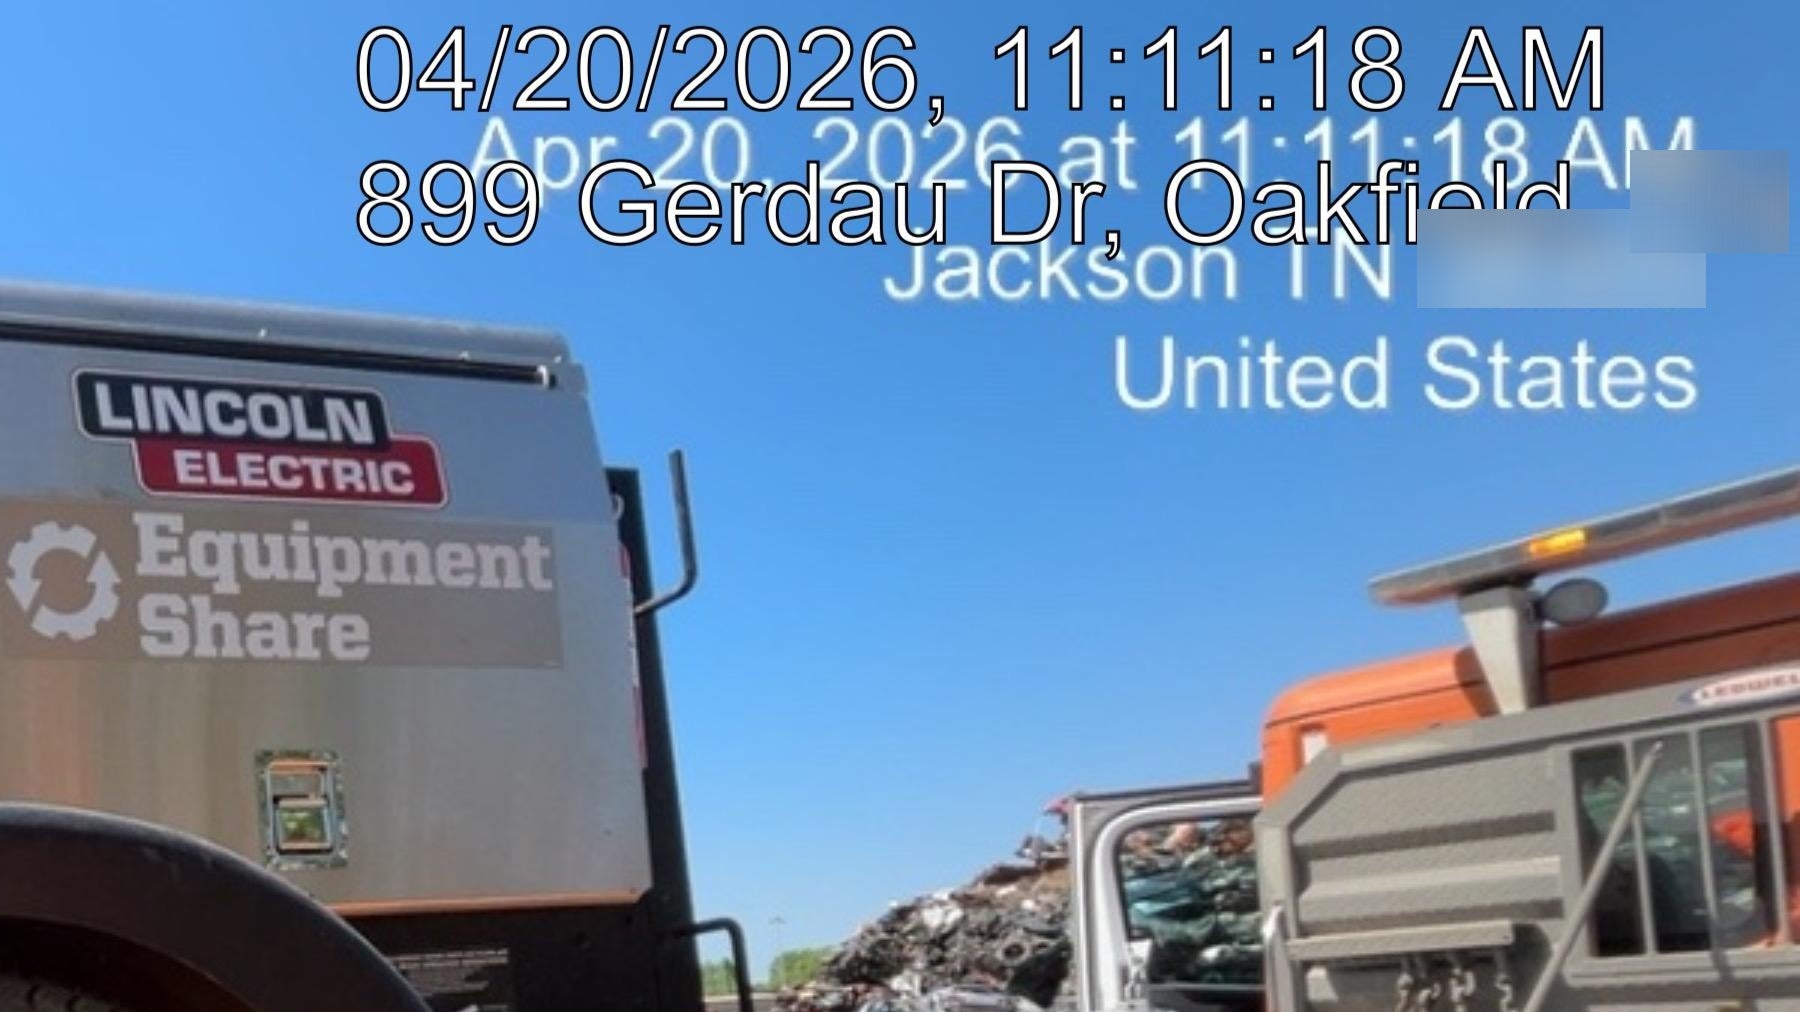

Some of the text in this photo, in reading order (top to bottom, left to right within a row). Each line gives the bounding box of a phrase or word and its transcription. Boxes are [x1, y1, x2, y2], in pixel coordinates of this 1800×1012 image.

[94, 380, 374, 445] LINCOLN
[174, 448, 416, 496] ELECTRIC
[133, 512, 554, 598] Equipment
[138, 592, 371, 662] Share
